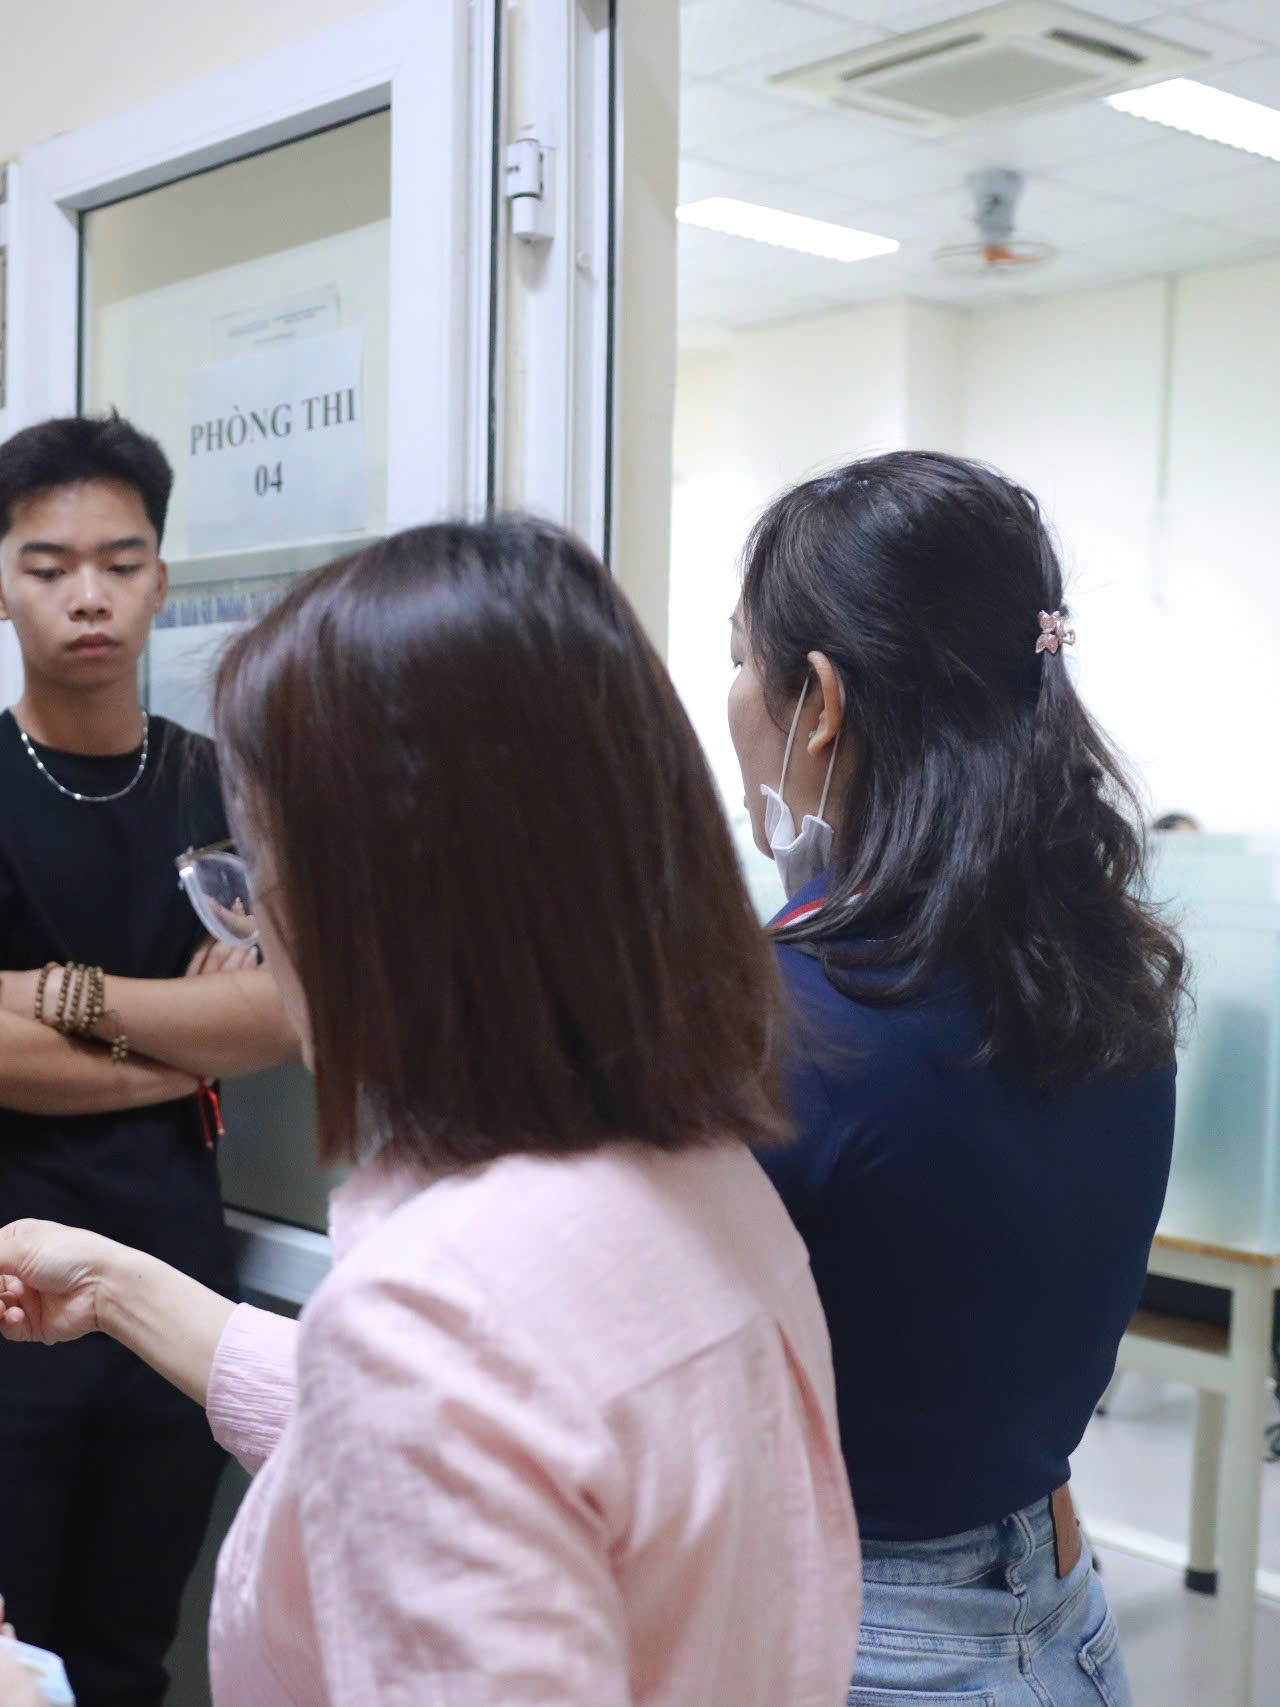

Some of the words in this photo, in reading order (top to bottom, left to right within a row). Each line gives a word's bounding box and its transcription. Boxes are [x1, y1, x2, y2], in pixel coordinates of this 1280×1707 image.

[190, 404, 293, 456] PHÒNG
[300, 388, 357, 432] THI
[253, 460, 284, 496] 04
